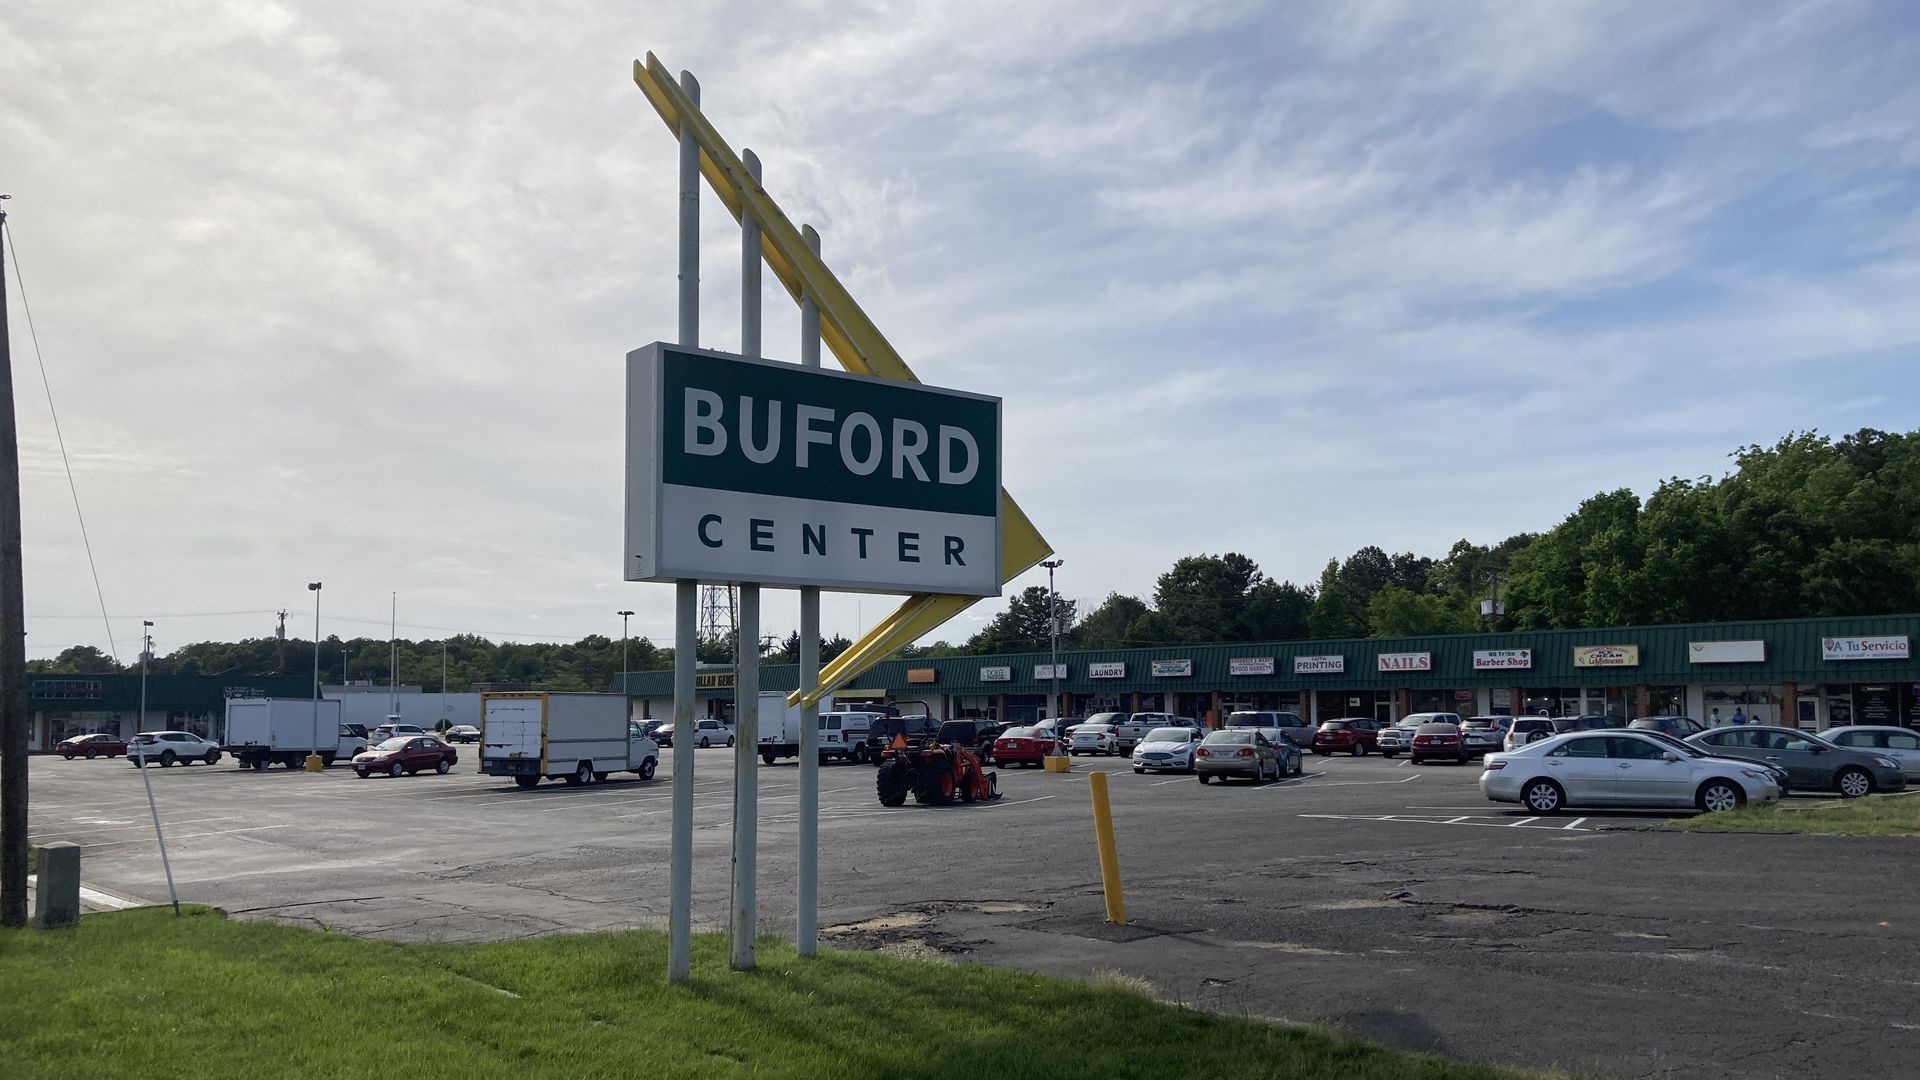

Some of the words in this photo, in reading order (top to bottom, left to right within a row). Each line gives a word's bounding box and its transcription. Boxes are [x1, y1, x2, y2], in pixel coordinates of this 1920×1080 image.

[684, 386, 980, 486] BUFORD
[697, 513, 967, 567] CENTER
[1833, 641, 1843, 651] A
[1847, 641, 1859, 651] Tu
[1861, 640, 1907, 651] Servicio
[1296, 661, 1342, 670] PRINTING
[1380, 656, 1428, 669] NAILS
[1475, 658, 1505, 667] Barber
[1507, 657, 1529, 667] Shop
[1090, 668, 1123, 677] LAUNDRY
[696, 675, 716, 687] OLLAR
